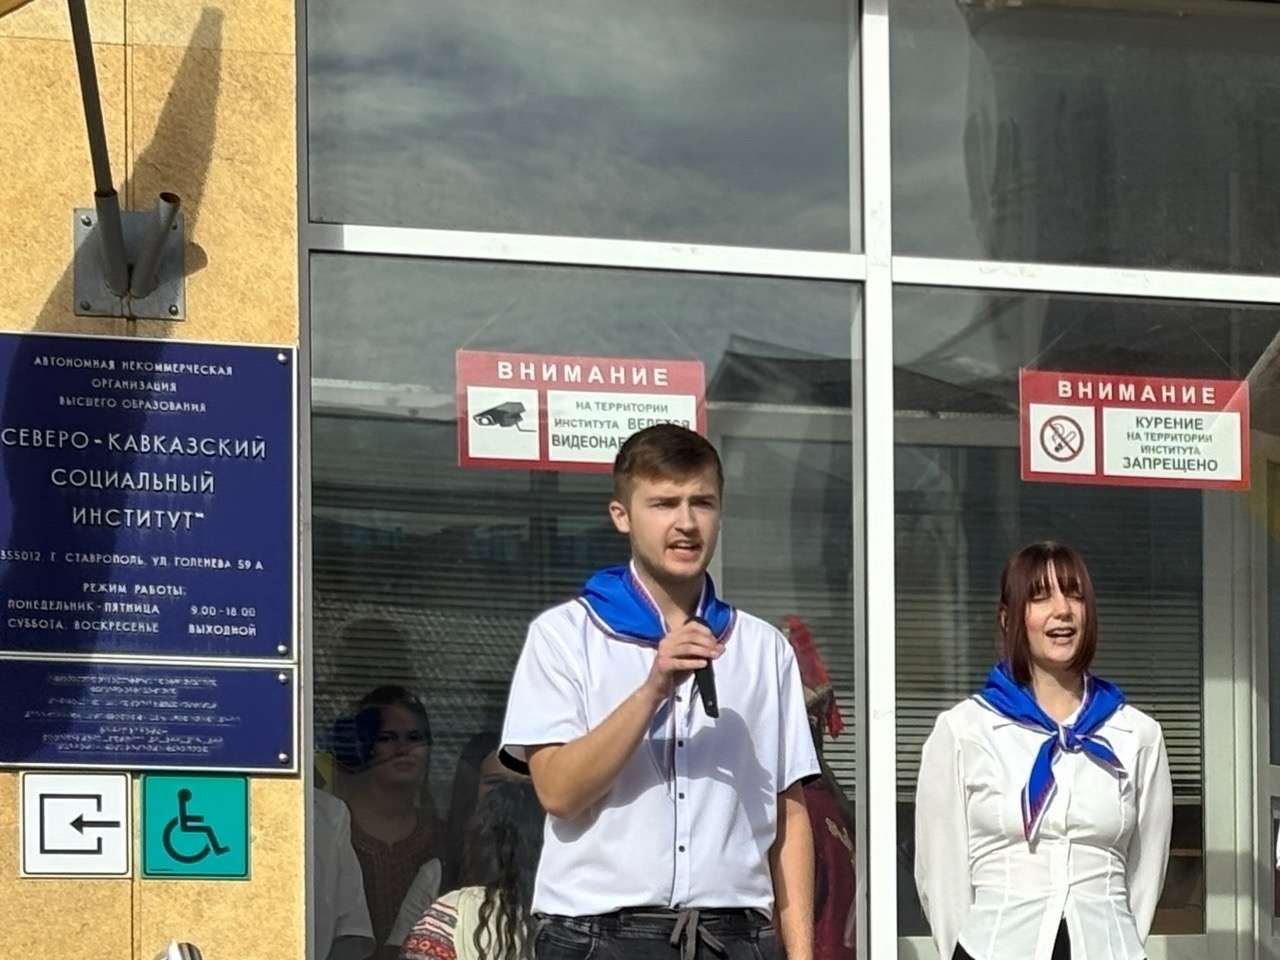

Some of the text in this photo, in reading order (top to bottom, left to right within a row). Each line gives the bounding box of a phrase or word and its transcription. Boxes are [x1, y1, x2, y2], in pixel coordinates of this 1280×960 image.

[33, 356, 233, 376] АВТОНОМНАЯ НЕКОММЕРЧЕСКАЯ
[497, 361, 669, 386] ВНИМАНИЕ
[91, 378, 177, 393] ОРГАНИЗАЦИЯ
[1057, 380, 1217, 405] ВНИМАНИЕ
[59, 396, 207, 413] ВЫСШЕГО ОБРАЗОВАНИЯ
[575, 401, 669, 413] НА ТЕРРИТОРИИ
[553, 418, 619, 430] ИНСТИТУТА
[1135, 416, 1204, 430] КУРЕНИЕ
[1127, 431, 1213, 443] НА ТЕРРИТОРИИ
[1140, 444, 1201, 455] ИНСТИТУТА
[1122, 456, 1219, 473] ЗАПРЕЩЕНО
[51, 467, 216, 494] СОЦИАЛЬНЫЙ
[174, 556, 232, 570] ГОЛЕНЕВА
[237, 559, 252, 570] 59
[255, 560, 264, 570] А
[82, 582, 187, 596] РЕЖИМ РАБОТЫ:
[104, 602, 160, 615] ПЯТНИЦА
[74, 620, 160, 633] ВОСКРЕСЕНЬЕ
[188, 623, 257, 636] ВЫХОДНОЙ
